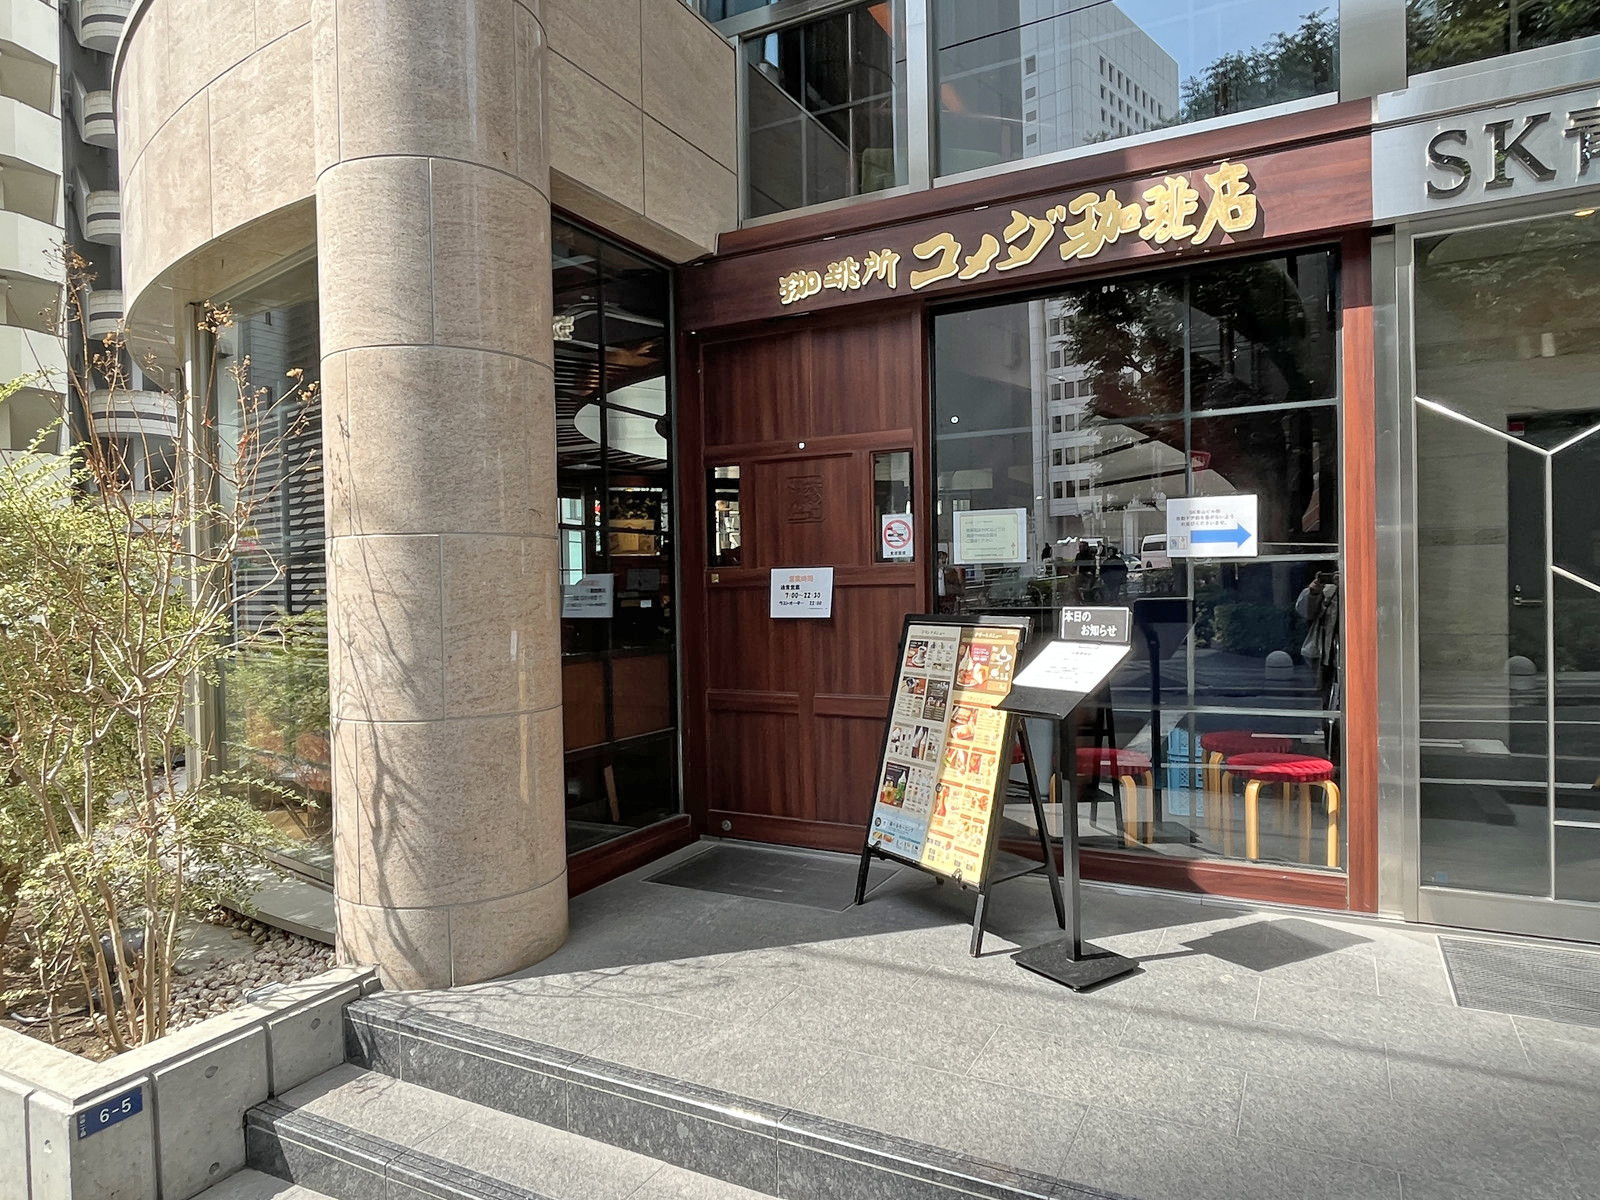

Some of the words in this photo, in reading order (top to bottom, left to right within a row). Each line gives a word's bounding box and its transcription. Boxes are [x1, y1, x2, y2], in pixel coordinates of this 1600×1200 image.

[910, 161, 1258, 290] コメダ珈琲店
[1064, 611, 1092, 623] 本日の
[1080, 624, 1118, 637] お知らせ
[99, 1097, 132, 1123] 6-5
